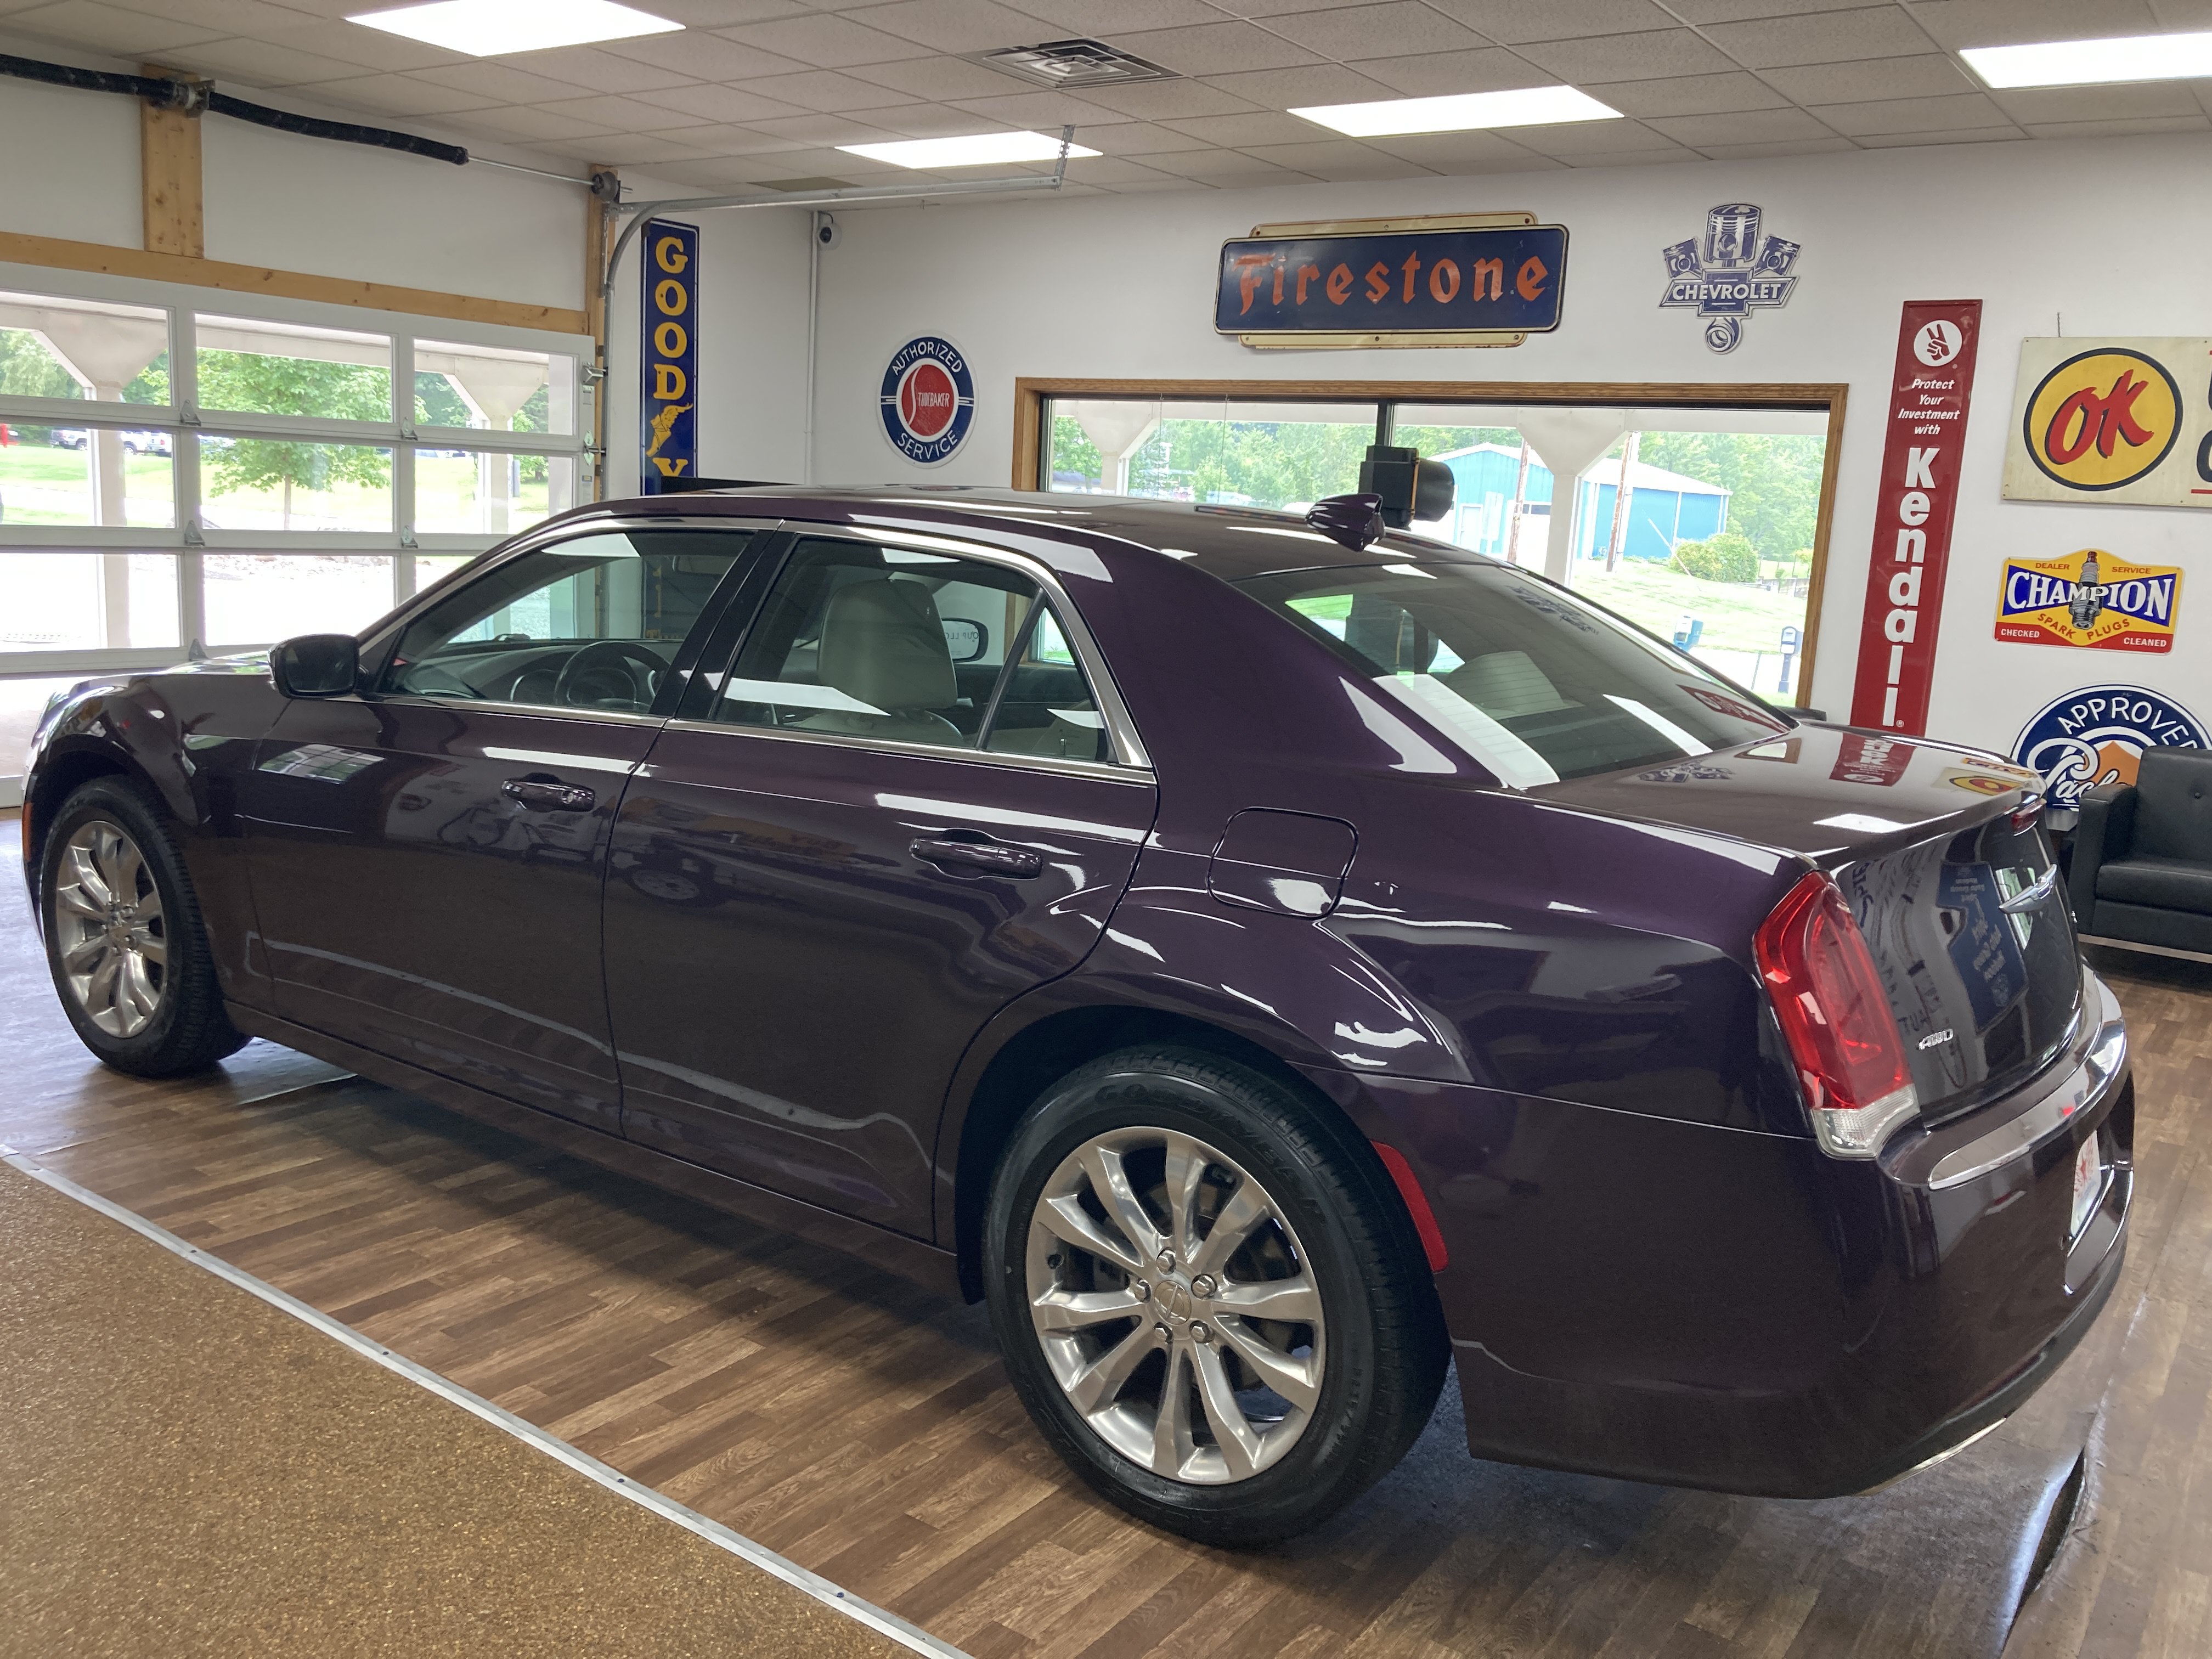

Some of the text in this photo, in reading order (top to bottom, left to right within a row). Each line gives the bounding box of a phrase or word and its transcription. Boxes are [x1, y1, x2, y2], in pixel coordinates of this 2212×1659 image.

[1234, 250, 1548, 315] Firestone
[1673, 284, 1781, 300] CHEVROLET
[892, 341, 962, 375] AUTHORIZED
[1911, 379, 1955, 390] Protect
[1919, 394, 1944, 405] Your
[1898, 408, 1960, 420] Investment
[2045, 369, 2154, 465] OK
[1914, 424, 1940, 435] with
[898, 430, 958, 460] SERVICE
[1882, 448, 1939, 726] Kendall
[2007, 571, 2173, 620] CHAMPION
[2001, 629, 2167, 647] CHECKED CLEANED
[2038, 613, 2130, 640] SPARK PLUGS
[1919, 1029, 1954, 1050] AWD
